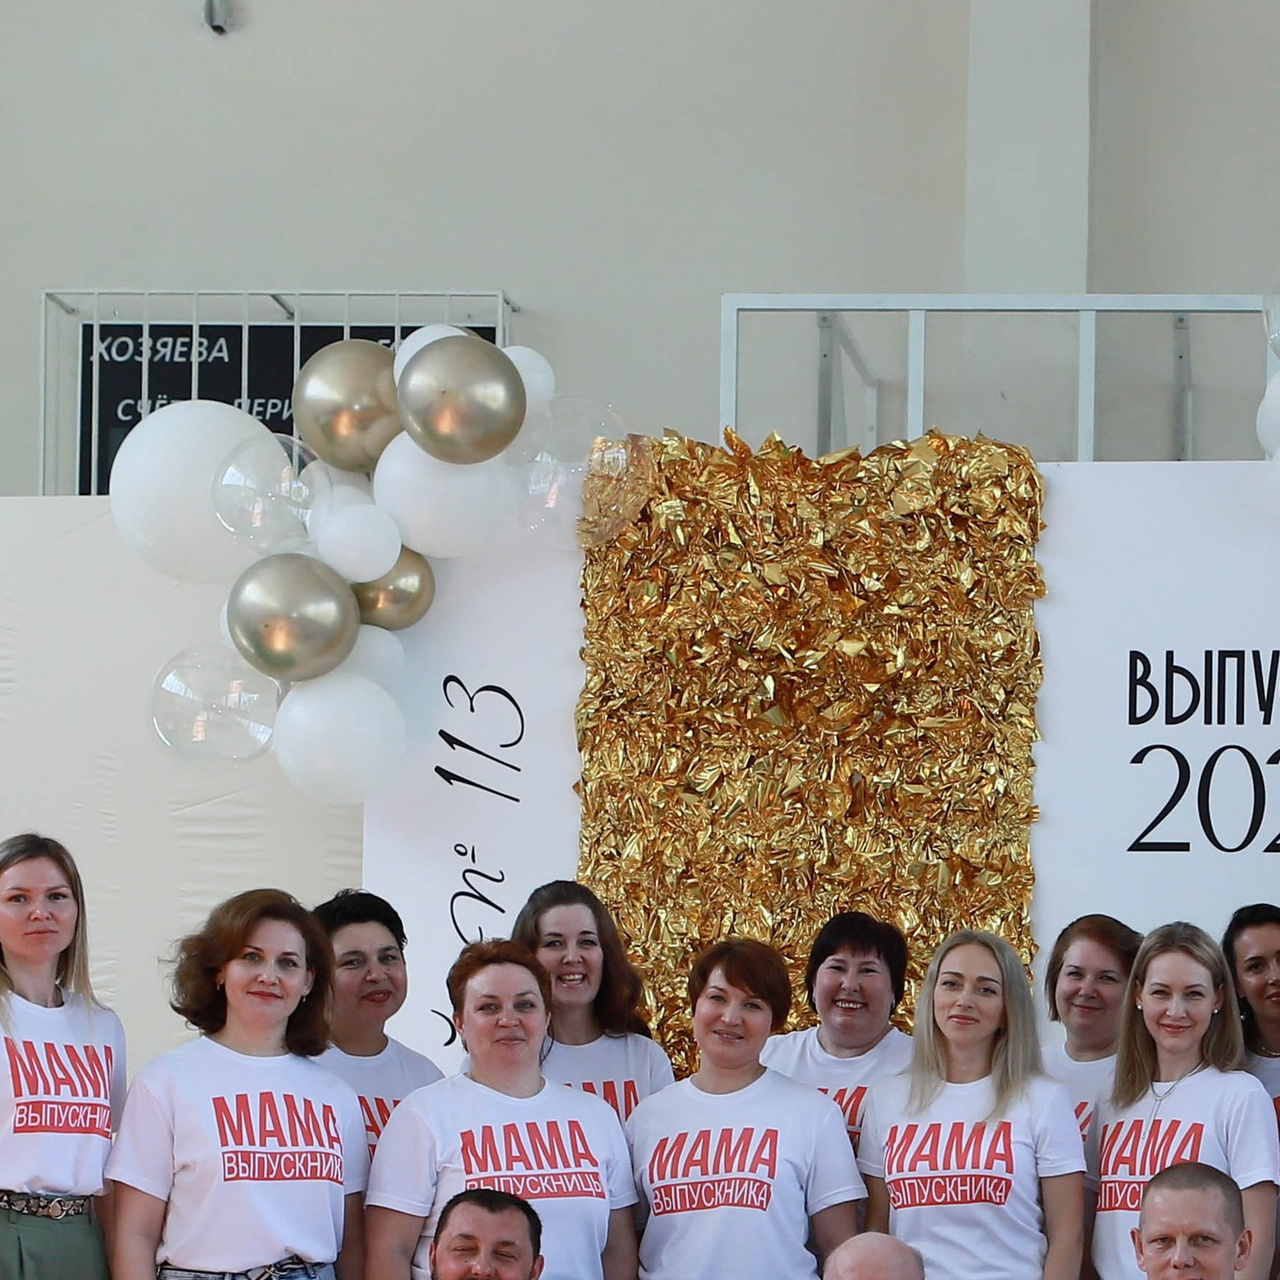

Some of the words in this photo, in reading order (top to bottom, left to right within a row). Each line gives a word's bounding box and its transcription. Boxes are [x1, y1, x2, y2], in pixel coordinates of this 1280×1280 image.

[90, 336, 230, 363] ХОЗЯЕВА
[434, 674, 525, 803] 113
[211, 1090, 344, 1156] МАМА
[460, 1119, 599, 1176] МАМА
[886, 1120, 1014, 1176] МАМА
[223, 1152, 344, 1181] ВЫПУСКНИК
[648, 1127, 779, 1185] МАМА
[652, 1179, 768, 1213] ВЫПУСКНИКА
